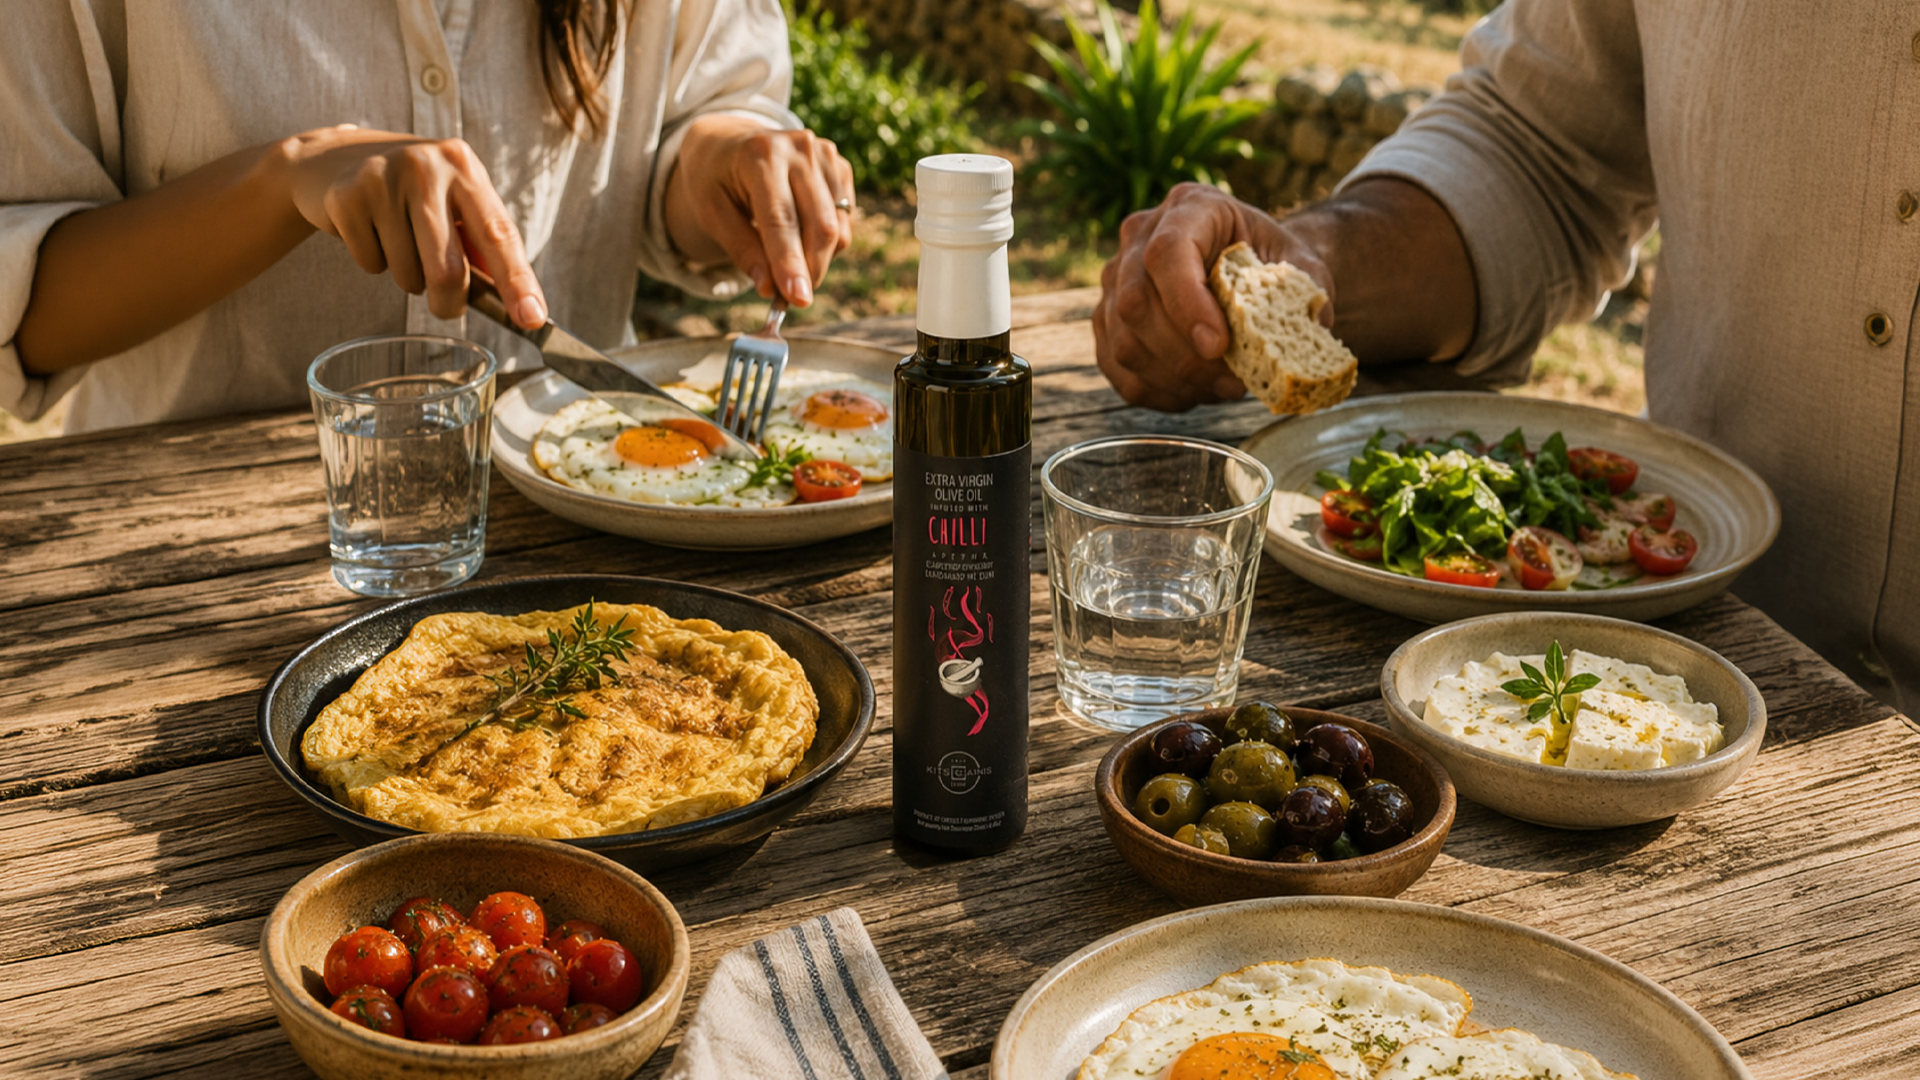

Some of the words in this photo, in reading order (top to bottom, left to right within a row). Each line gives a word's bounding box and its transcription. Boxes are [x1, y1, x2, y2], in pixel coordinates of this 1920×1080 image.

[925, 472, 956, 487] EXTRA
[958, 472, 994, 487] VIRGIN
[935, 488, 964, 502] OLIVE
[966, 488, 983, 502] OIL
[928, 515, 987, 546] CHILLI
